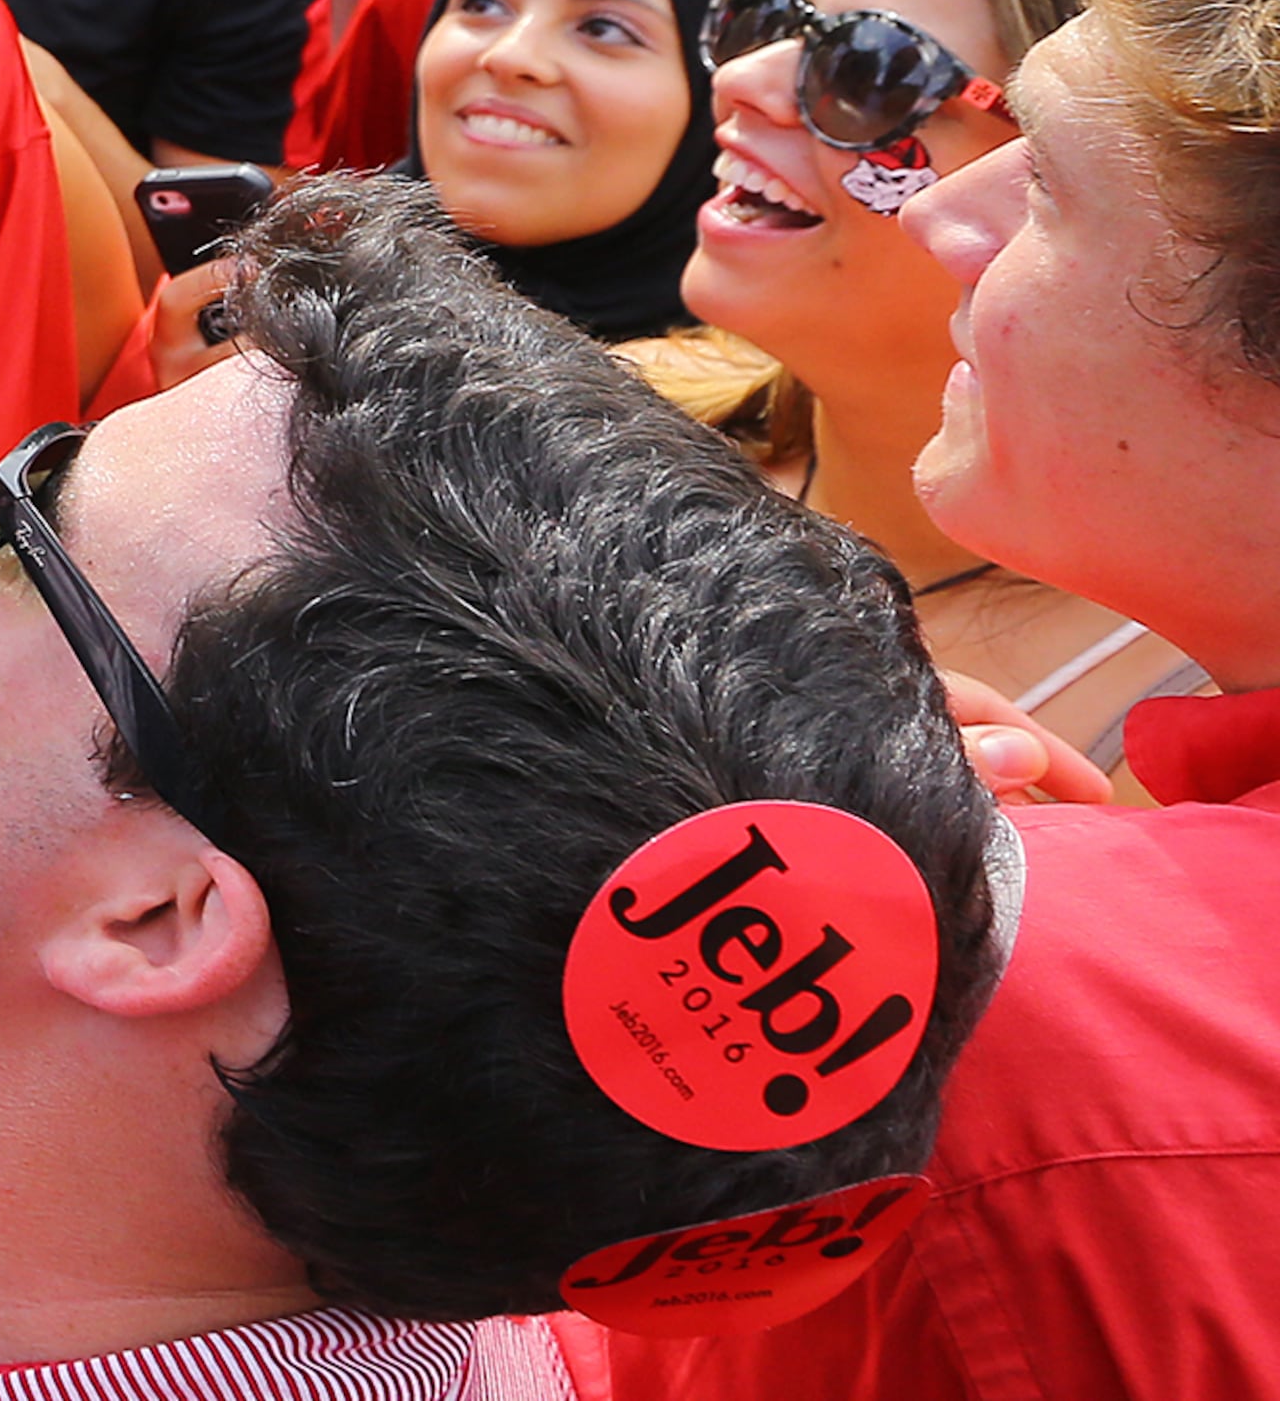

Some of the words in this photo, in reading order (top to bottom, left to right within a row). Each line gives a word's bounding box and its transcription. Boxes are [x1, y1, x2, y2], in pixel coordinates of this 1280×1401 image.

[608, 824, 914, 1117] Jeb!
[657, 959, 753, 1065] 2016
[609, 1000, 697, 1102] Jeb2016.com
[570, 1186, 912, 1289] Jeb!
[665, 1254, 786, 1280] 2016
